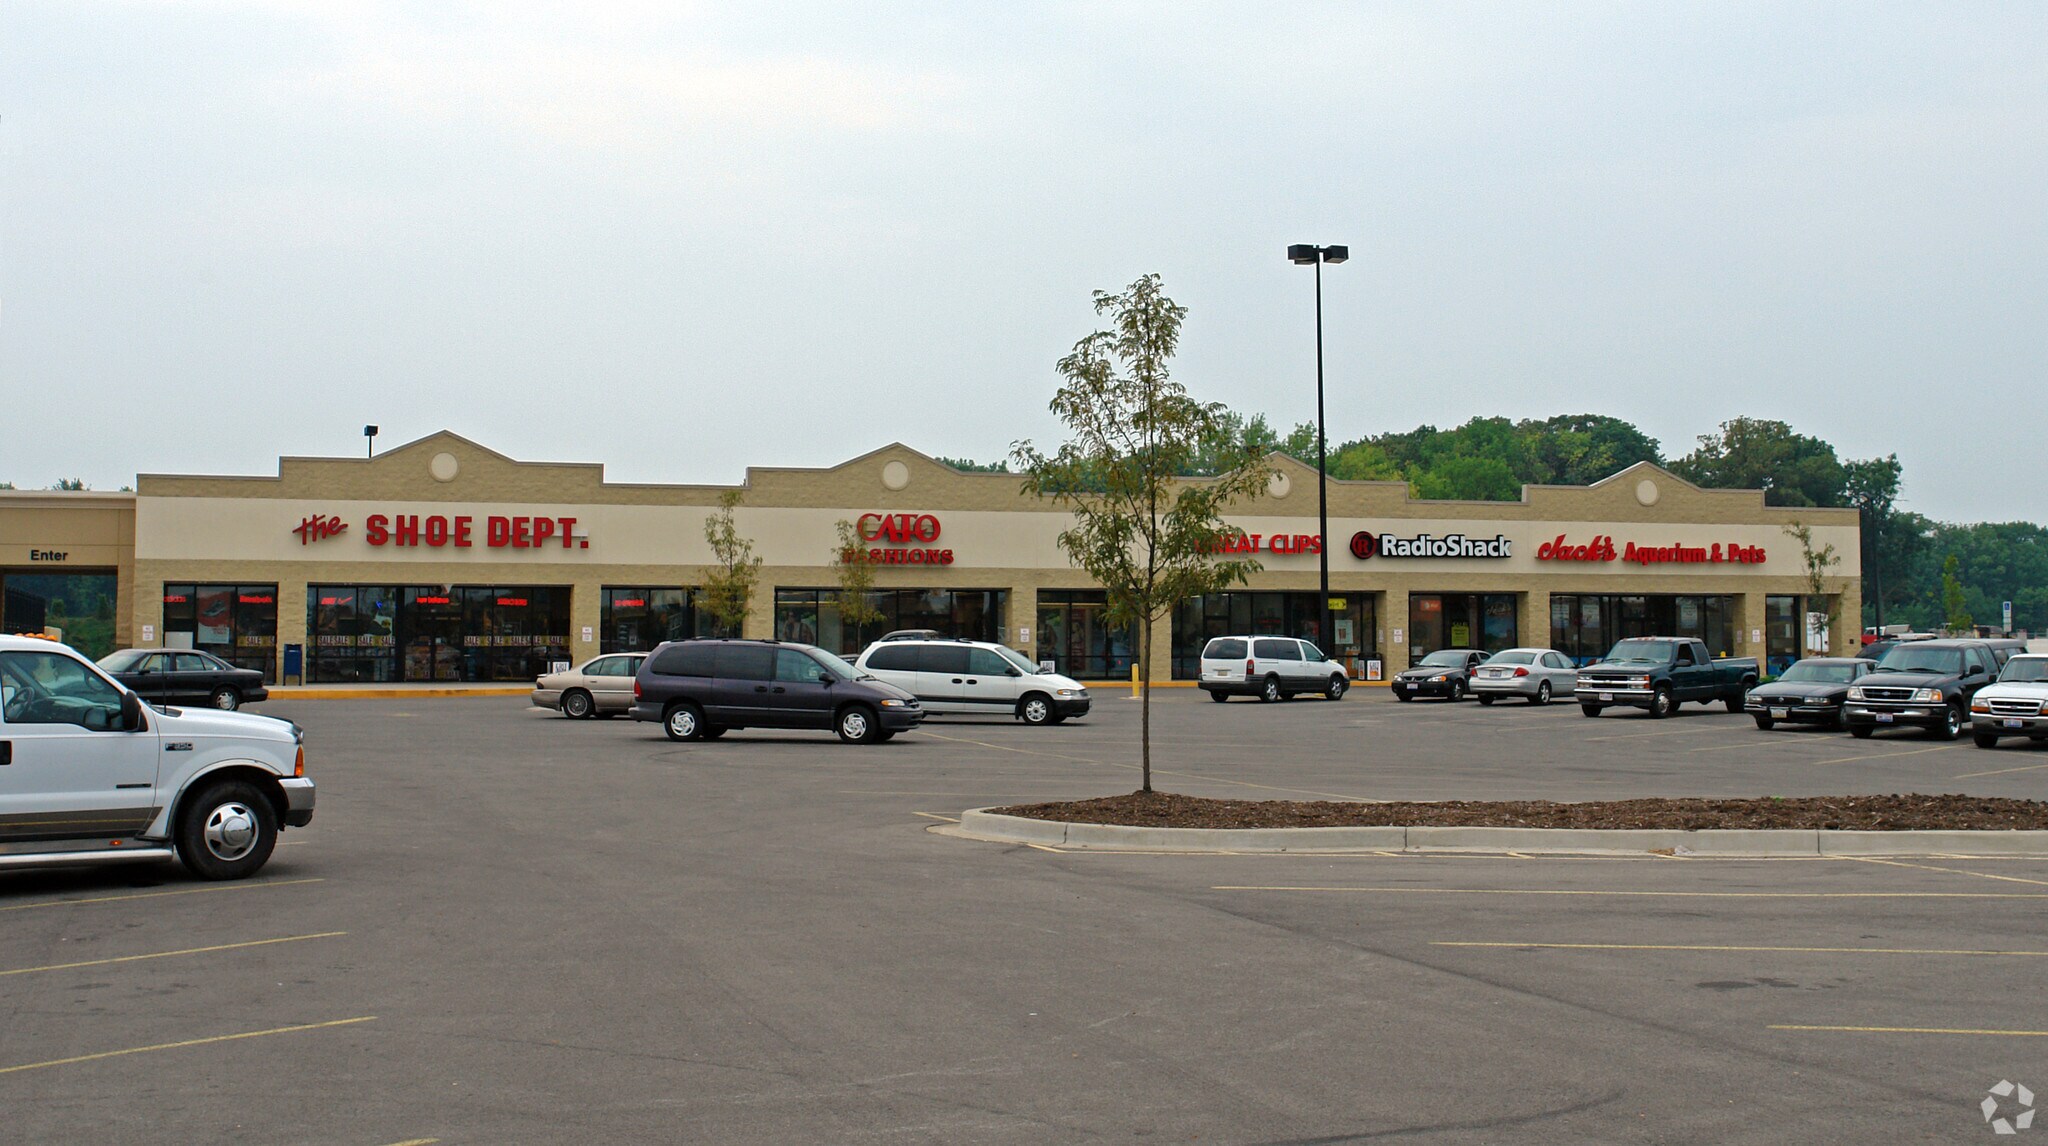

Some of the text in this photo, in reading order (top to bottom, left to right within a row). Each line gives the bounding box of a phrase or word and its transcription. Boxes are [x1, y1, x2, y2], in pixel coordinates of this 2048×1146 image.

[366, 514, 472, 547] SHOE
[487, 516, 589, 548] DEPT.
[856, 513, 942, 543] CATO
[30, 549, 69, 561] Enter
[1268, 534, 1322, 554] CLIPS
[1381, 535, 1512, 557] RadioShack
[1536, 533, 1766, 566] Jack's Aquarium & Pets
